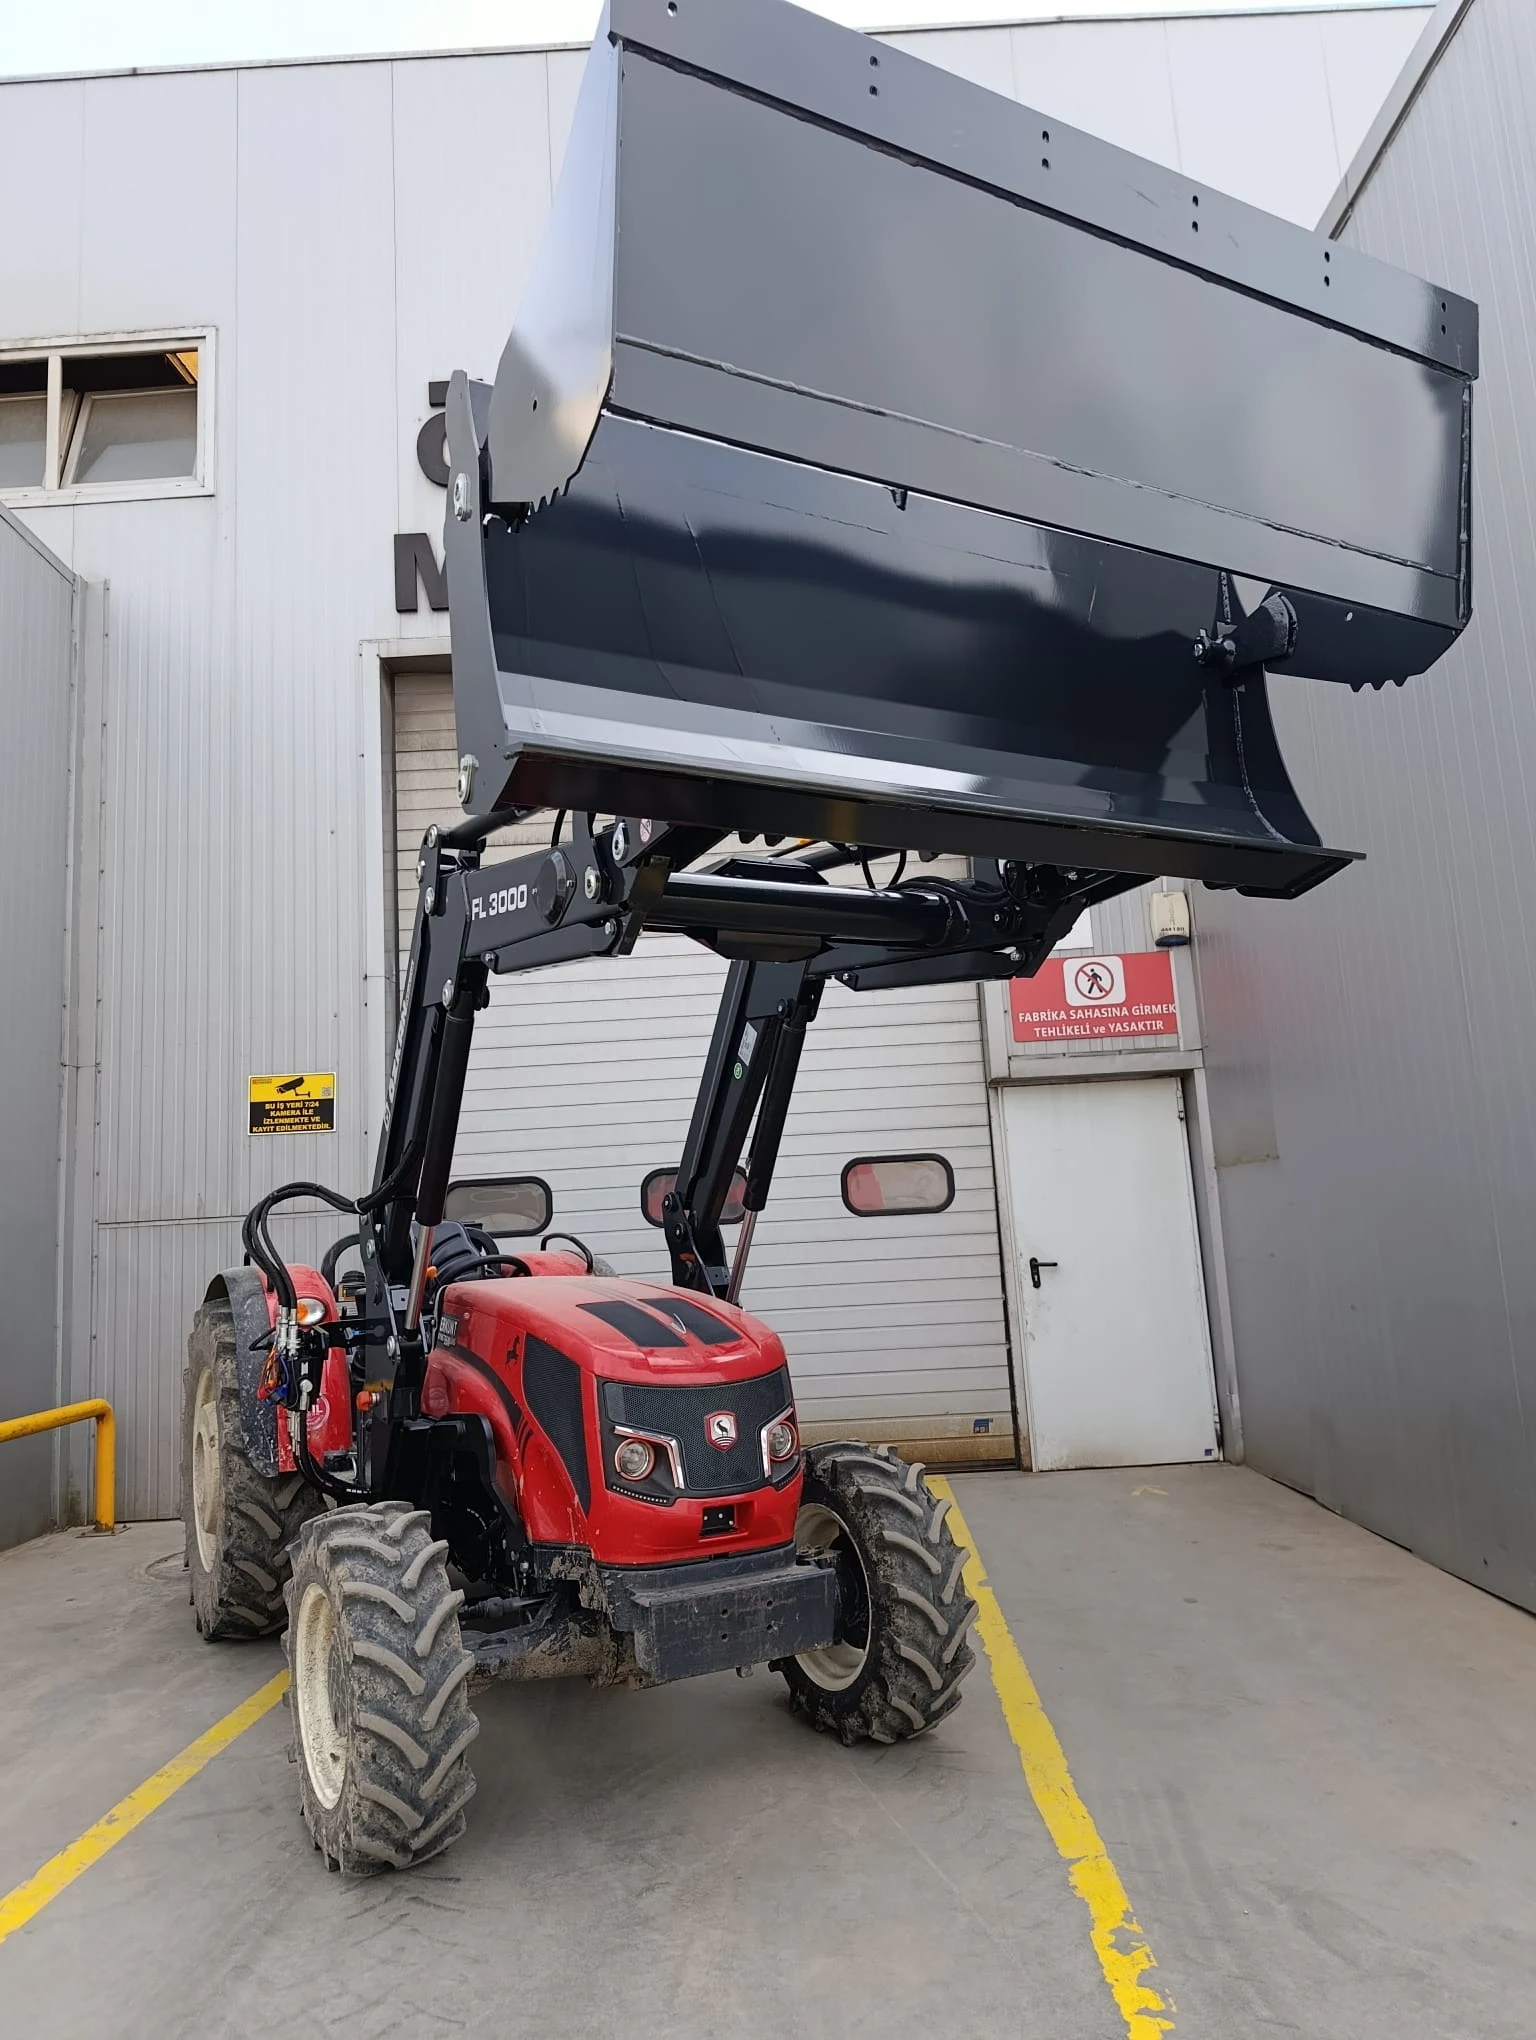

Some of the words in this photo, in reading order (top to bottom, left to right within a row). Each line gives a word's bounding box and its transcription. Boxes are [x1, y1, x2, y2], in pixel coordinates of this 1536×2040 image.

[471, 896, 487, 921] FL
[488, 884, 528, 917] 3000
[1018, 1008, 1067, 1023] FABRİKA
[1069, 1005, 1129, 1020] SAHASINA
[1131, 1002, 1177, 1016] GİRMEK
[1033, 1024, 1091, 1038] TEHLİKELİ
[1093, 1026, 1105, 1034] ve
[1108, 1020, 1164, 1033] YASAKTIR
[265, 1102, 276, 1110] BU
[277, 1101, 285, 1110] İŞ
[286, 1100, 303, 1109] YERİ
[270, 1109, 301, 1117] KAMERA
[263, 1117, 310, 1125] İZLENMEKTE
